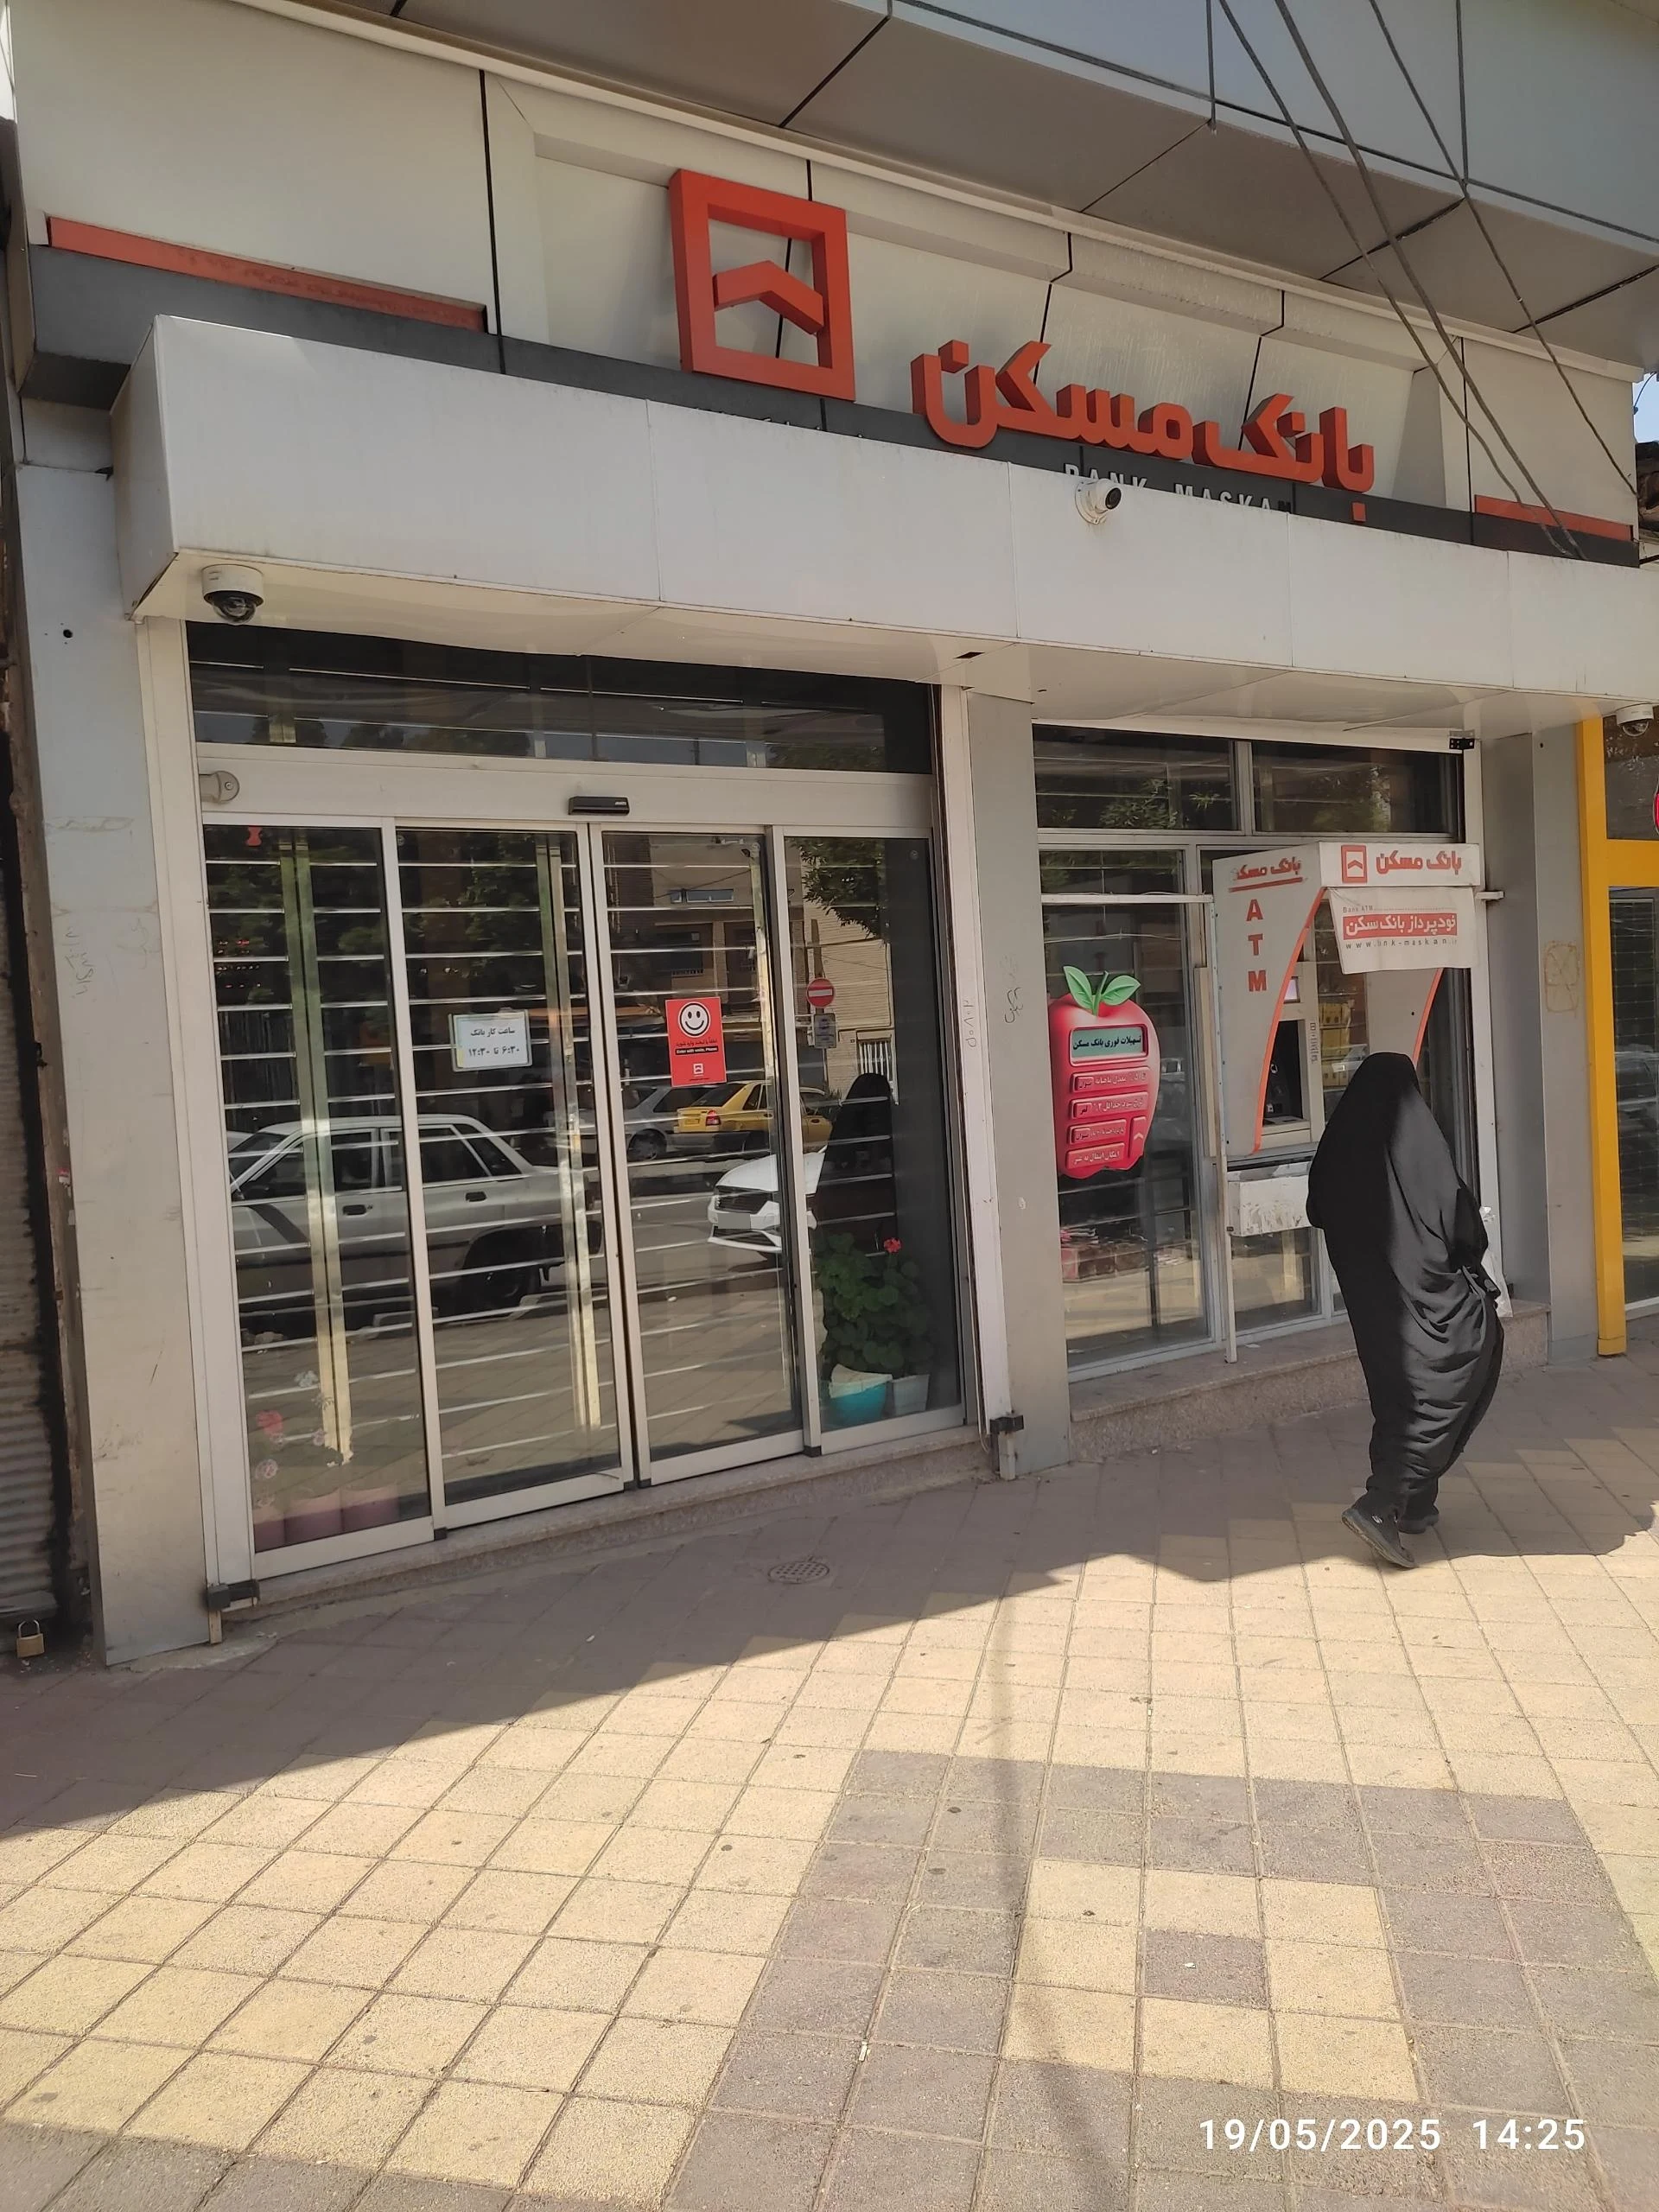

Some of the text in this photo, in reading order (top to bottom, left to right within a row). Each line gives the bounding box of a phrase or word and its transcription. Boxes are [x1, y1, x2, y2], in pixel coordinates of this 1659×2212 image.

[910, 340, 1374, 523] بانک مسکن
[1232, 856, 1301, 880] بانک مسک
[1376, 850, 1462, 875] بانک مسکن
[1380, 915, 1405, 933] بانک
[1408, 914, 1456, 935] خودپرداز
[1246, 899, 1268, 993] ATM
[486, 1027, 497, 1038] کار
[1073, 1035, 1142, 1050] تسهیلات فوری بانک مسکن
